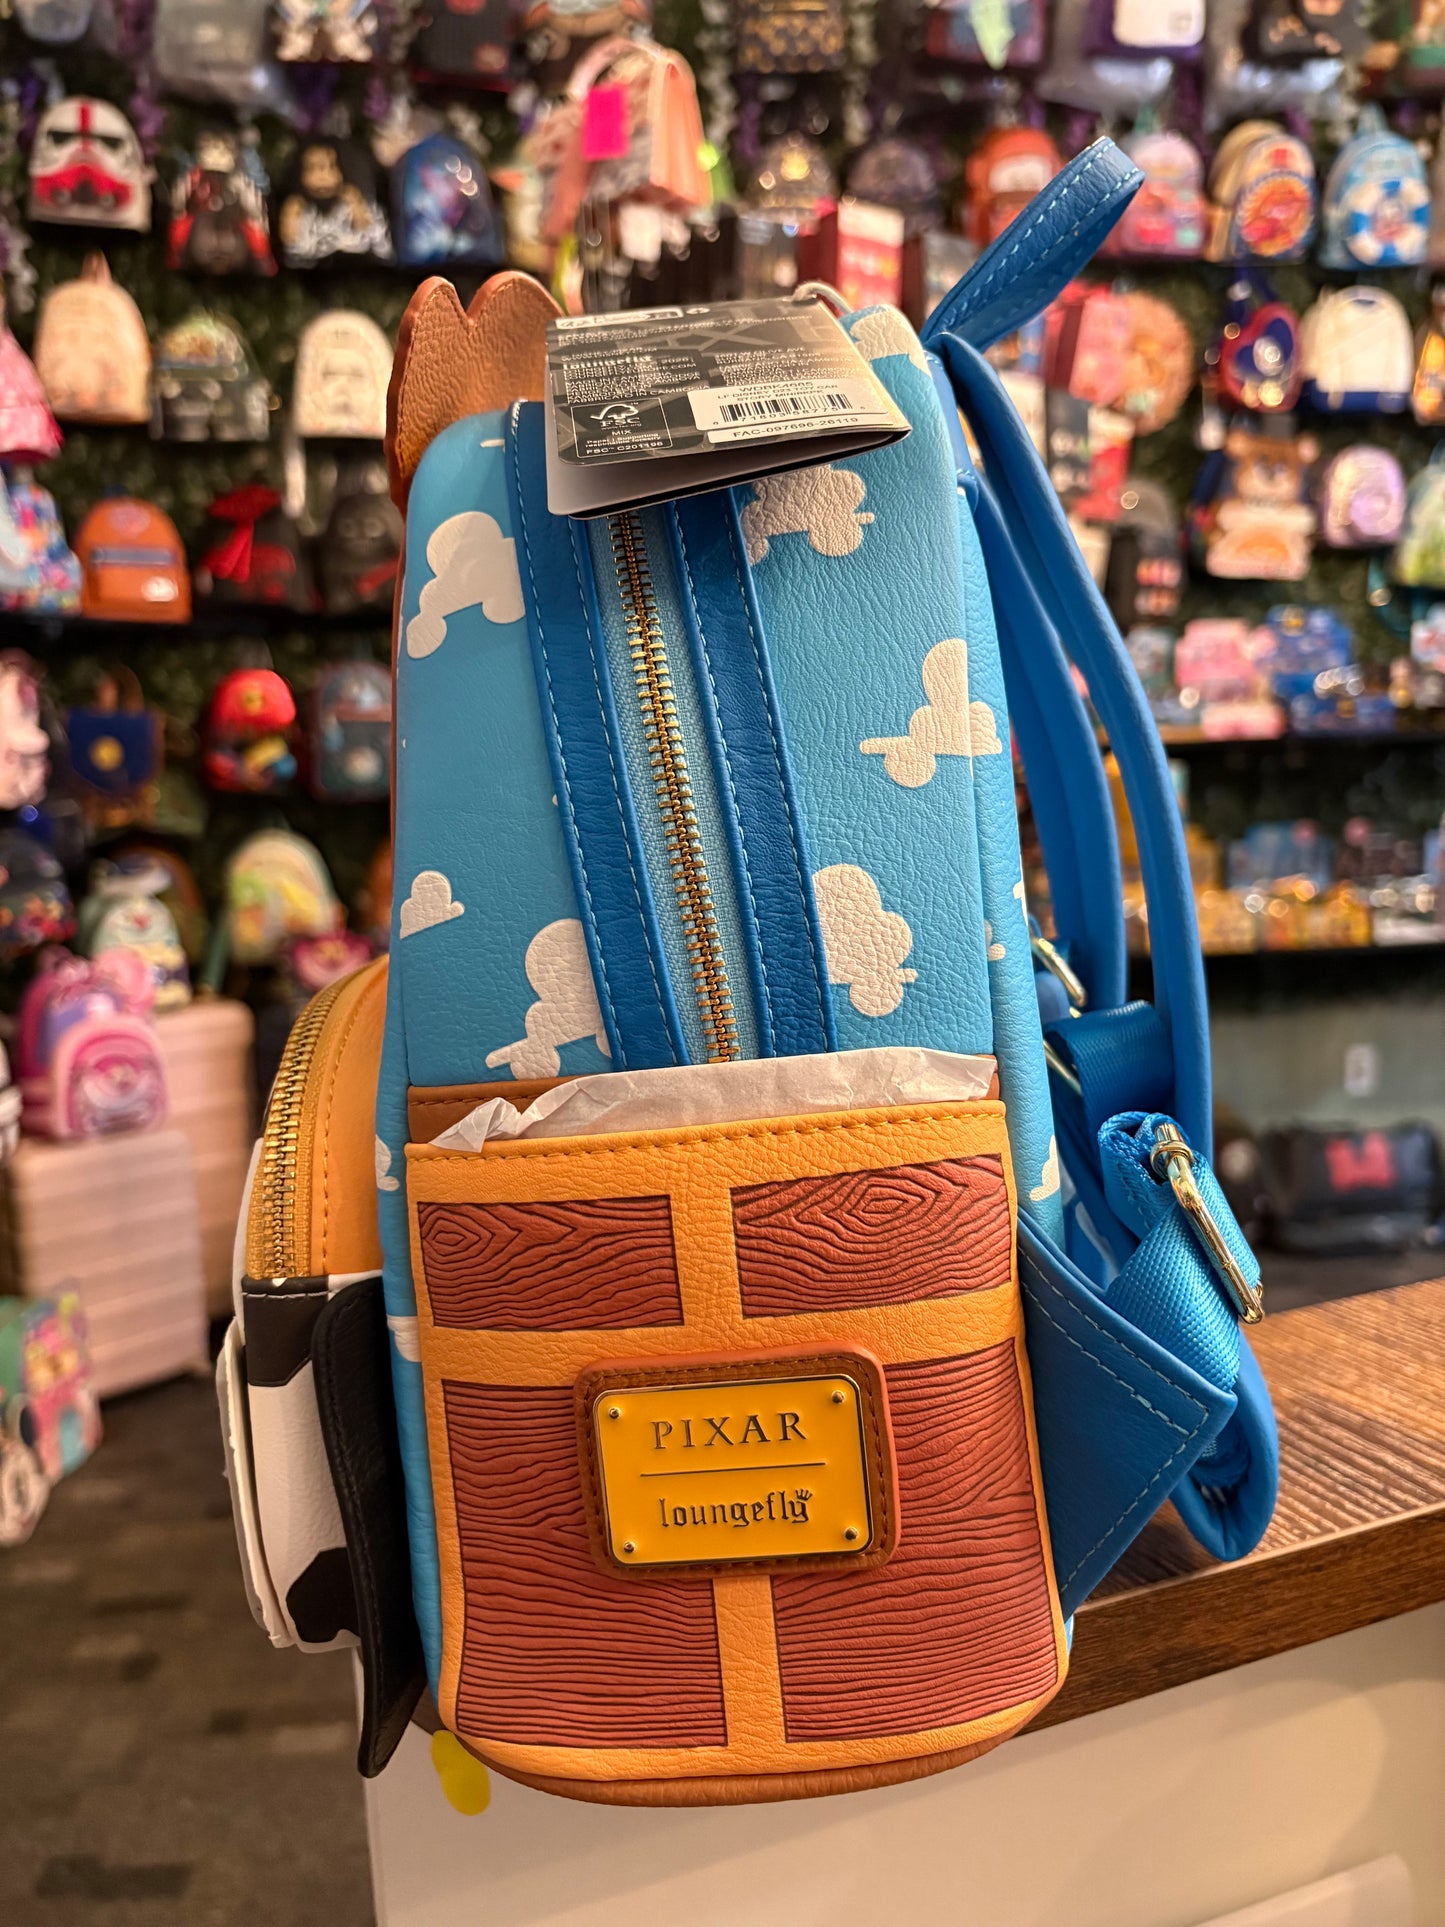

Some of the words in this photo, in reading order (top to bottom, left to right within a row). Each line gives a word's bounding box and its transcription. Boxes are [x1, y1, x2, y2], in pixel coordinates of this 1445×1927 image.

[600, 418, 640, 426] FSC
[650, 1411, 808, 1450] PIXAR
[658, 1489, 812, 1528] loungefly
